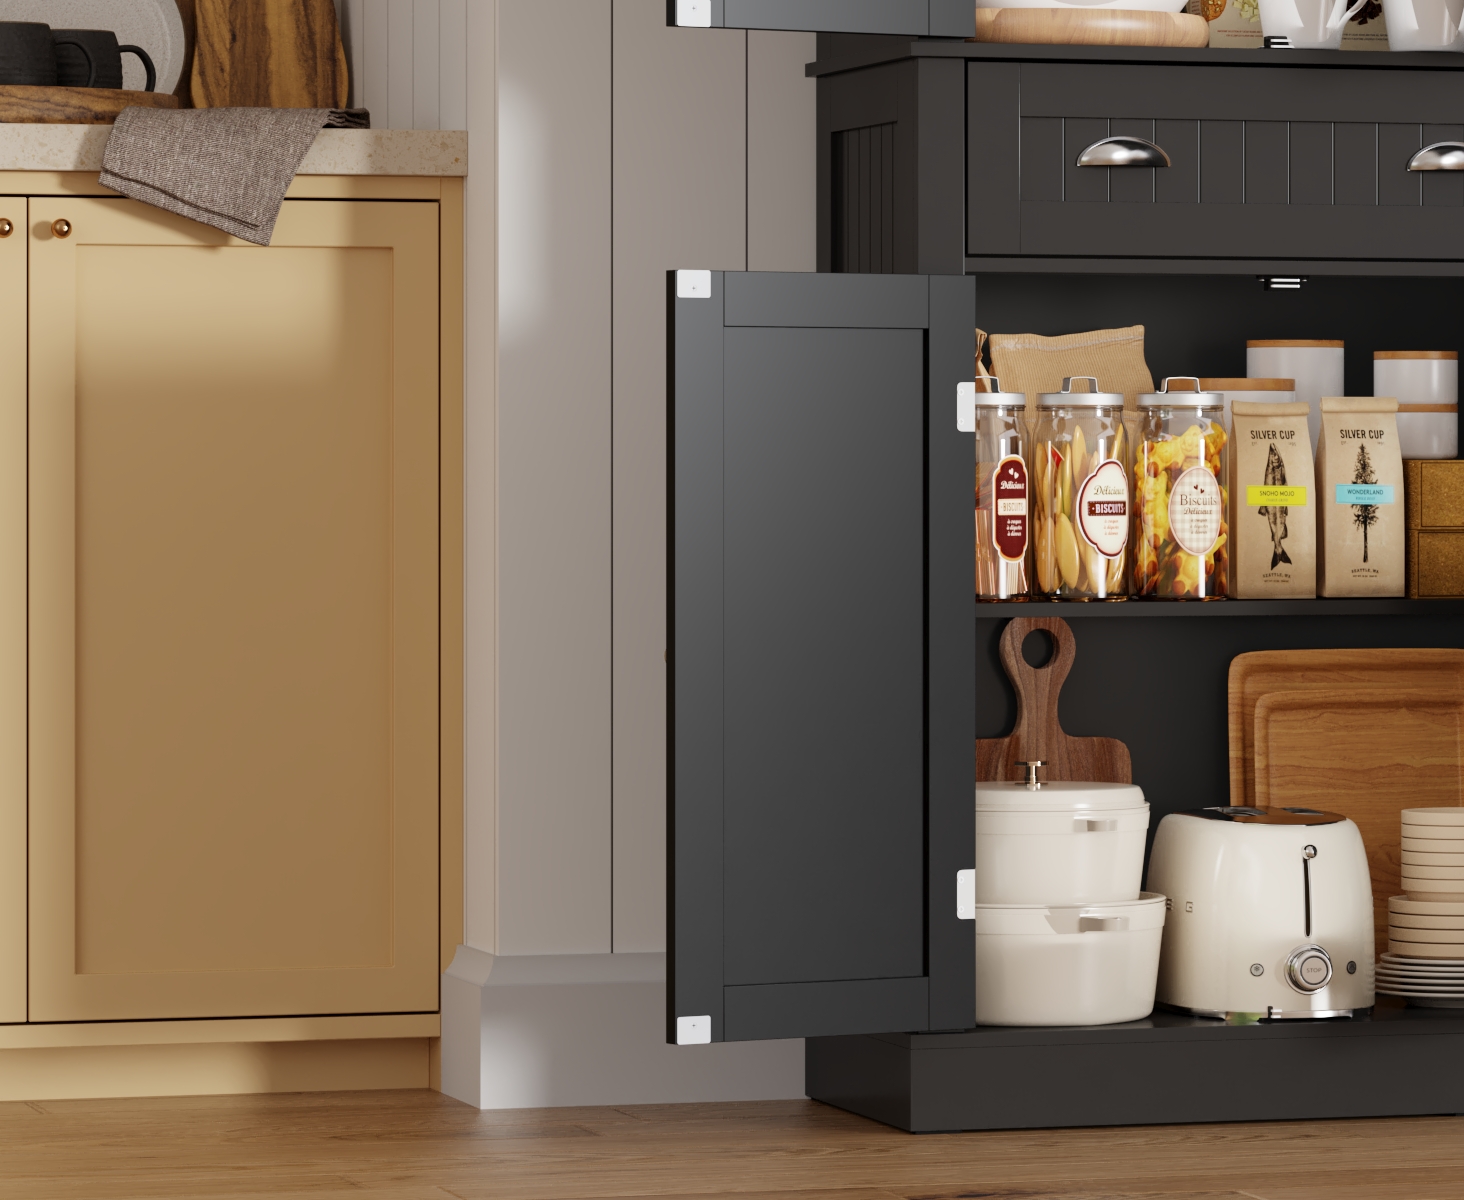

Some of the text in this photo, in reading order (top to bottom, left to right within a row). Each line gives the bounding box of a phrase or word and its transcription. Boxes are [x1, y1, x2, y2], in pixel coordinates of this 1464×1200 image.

[1250, 430, 1295, 440] SILVER CUP
[1340, 429, 1384, 439] SILVER CUP
[1093, 484, 1125, 496] Délicieux
[1347, 488, 1384, 496] WONDERLAND
[1180, 493, 1217, 506] Biscuits
[1094, 503, 1125, 514] BISCUITS
